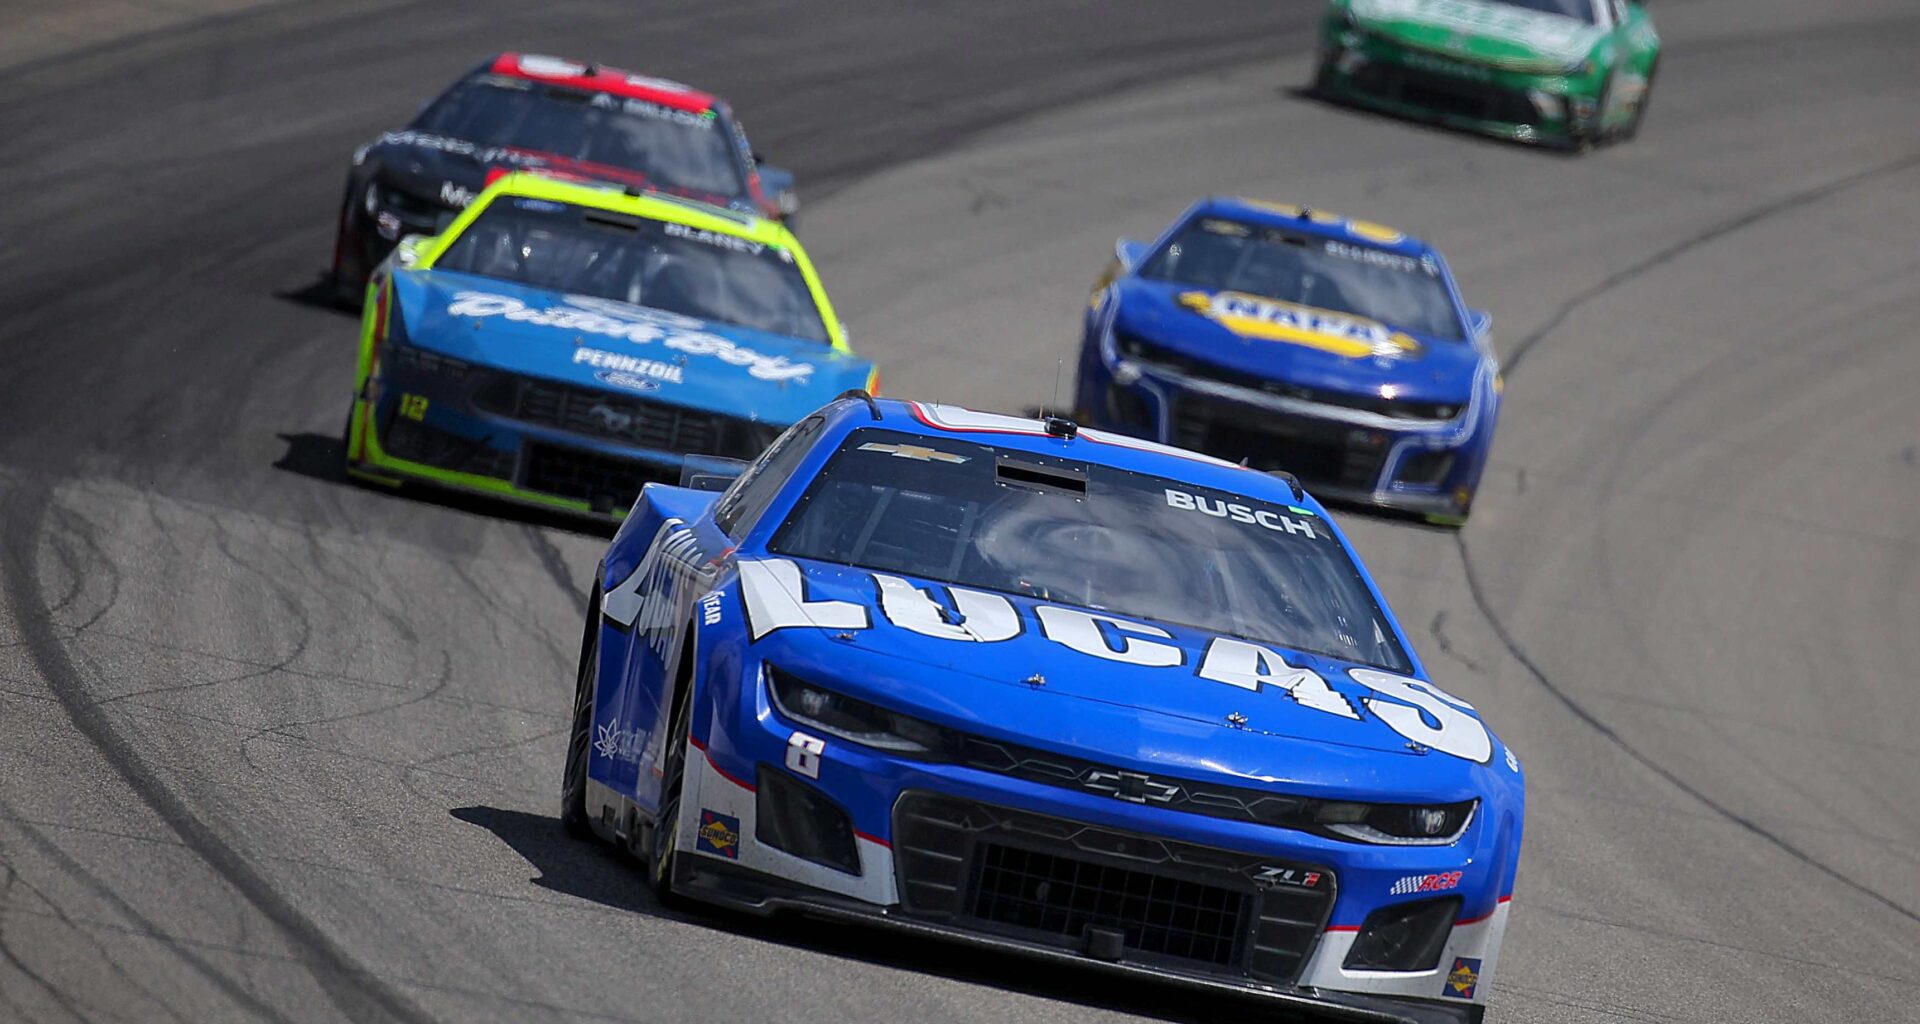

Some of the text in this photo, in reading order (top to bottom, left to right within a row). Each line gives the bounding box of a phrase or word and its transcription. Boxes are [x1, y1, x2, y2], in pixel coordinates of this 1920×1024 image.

[572, 347, 683, 384] PENNZOIL
[1165, 488, 1317, 539] BUSCH
[737, 558, 1492, 764] LUCAS
[785, 731, 826, 780] 8
[700, 825, 738, 845] SUNOCO
[1252, 865, 1321, 887] ZL1
